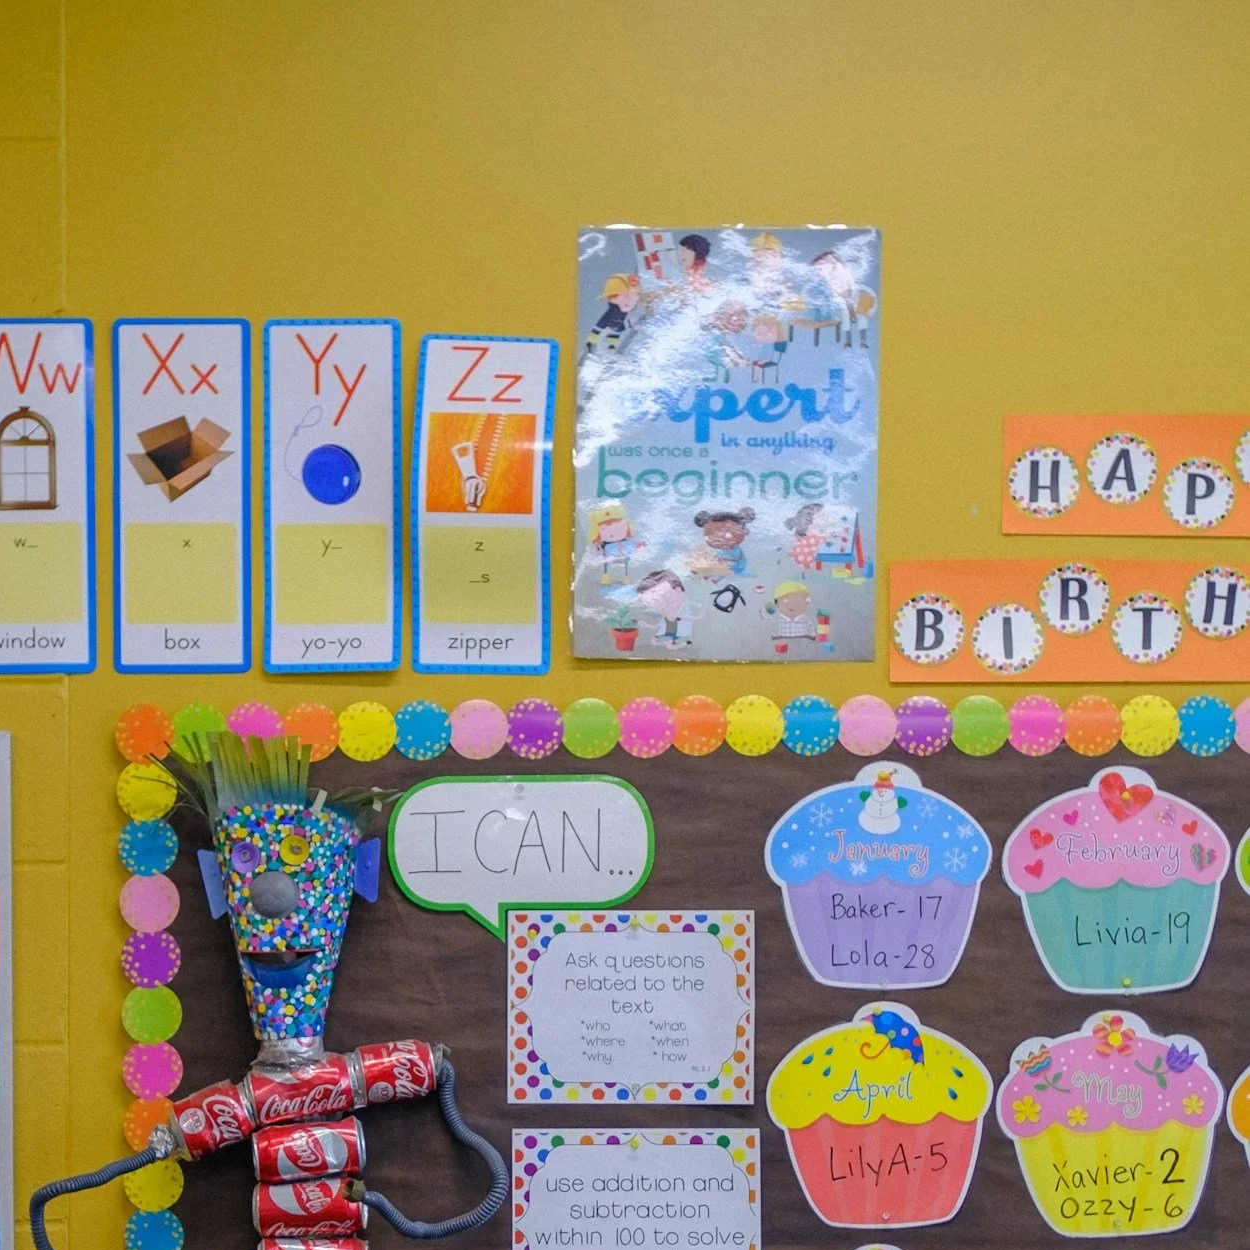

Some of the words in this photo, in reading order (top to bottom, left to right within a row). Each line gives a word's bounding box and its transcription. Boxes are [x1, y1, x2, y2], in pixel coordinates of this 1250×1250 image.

[142, 332, 218, 394] Xx
[448, 346, 523, 403] Zz
[296, 332, 366, 426] Yy
[608, 445, 642, 457] was
[649, 446, 693, 457] once
[698, 447, 709, 457] a
[721, 432, 739, 448] in
[746, 432, 836, 456] anything
[596, 445, 858, 505] beginner
[164, 629, 200, 651] box
[302, 633, 362, 659] yo-yo
[448, 632, 514, 658] zipper
[409, 810, 465, 874] I
[828, 829, 929, 878] January
[1056, 832, 1179, 876] February
[565, 952, 598, 968] Ask
[605, 953, 704, 972] questions
[565, 975, 636, 991] related
[644, 977, 665, 991] to
[672, 977, 704, 991] the
[612, 1000, 654, 1013] text
[833, 1069, 912, 1119] April
[1071, 1070, 1142, 1118] May
[546, 1177, 584, 1192] use
[592, 1174, 684, 1192] addition
[693, 1174, 734, 1192] and
[570, 1201, 709, 1219] subtraction
[535, 1228, 602, 1246] within
[616, 1228, 645, 1246] 100
[654, 1229, 679, 1246] to
[688, 1226, 745, 1246] solve
